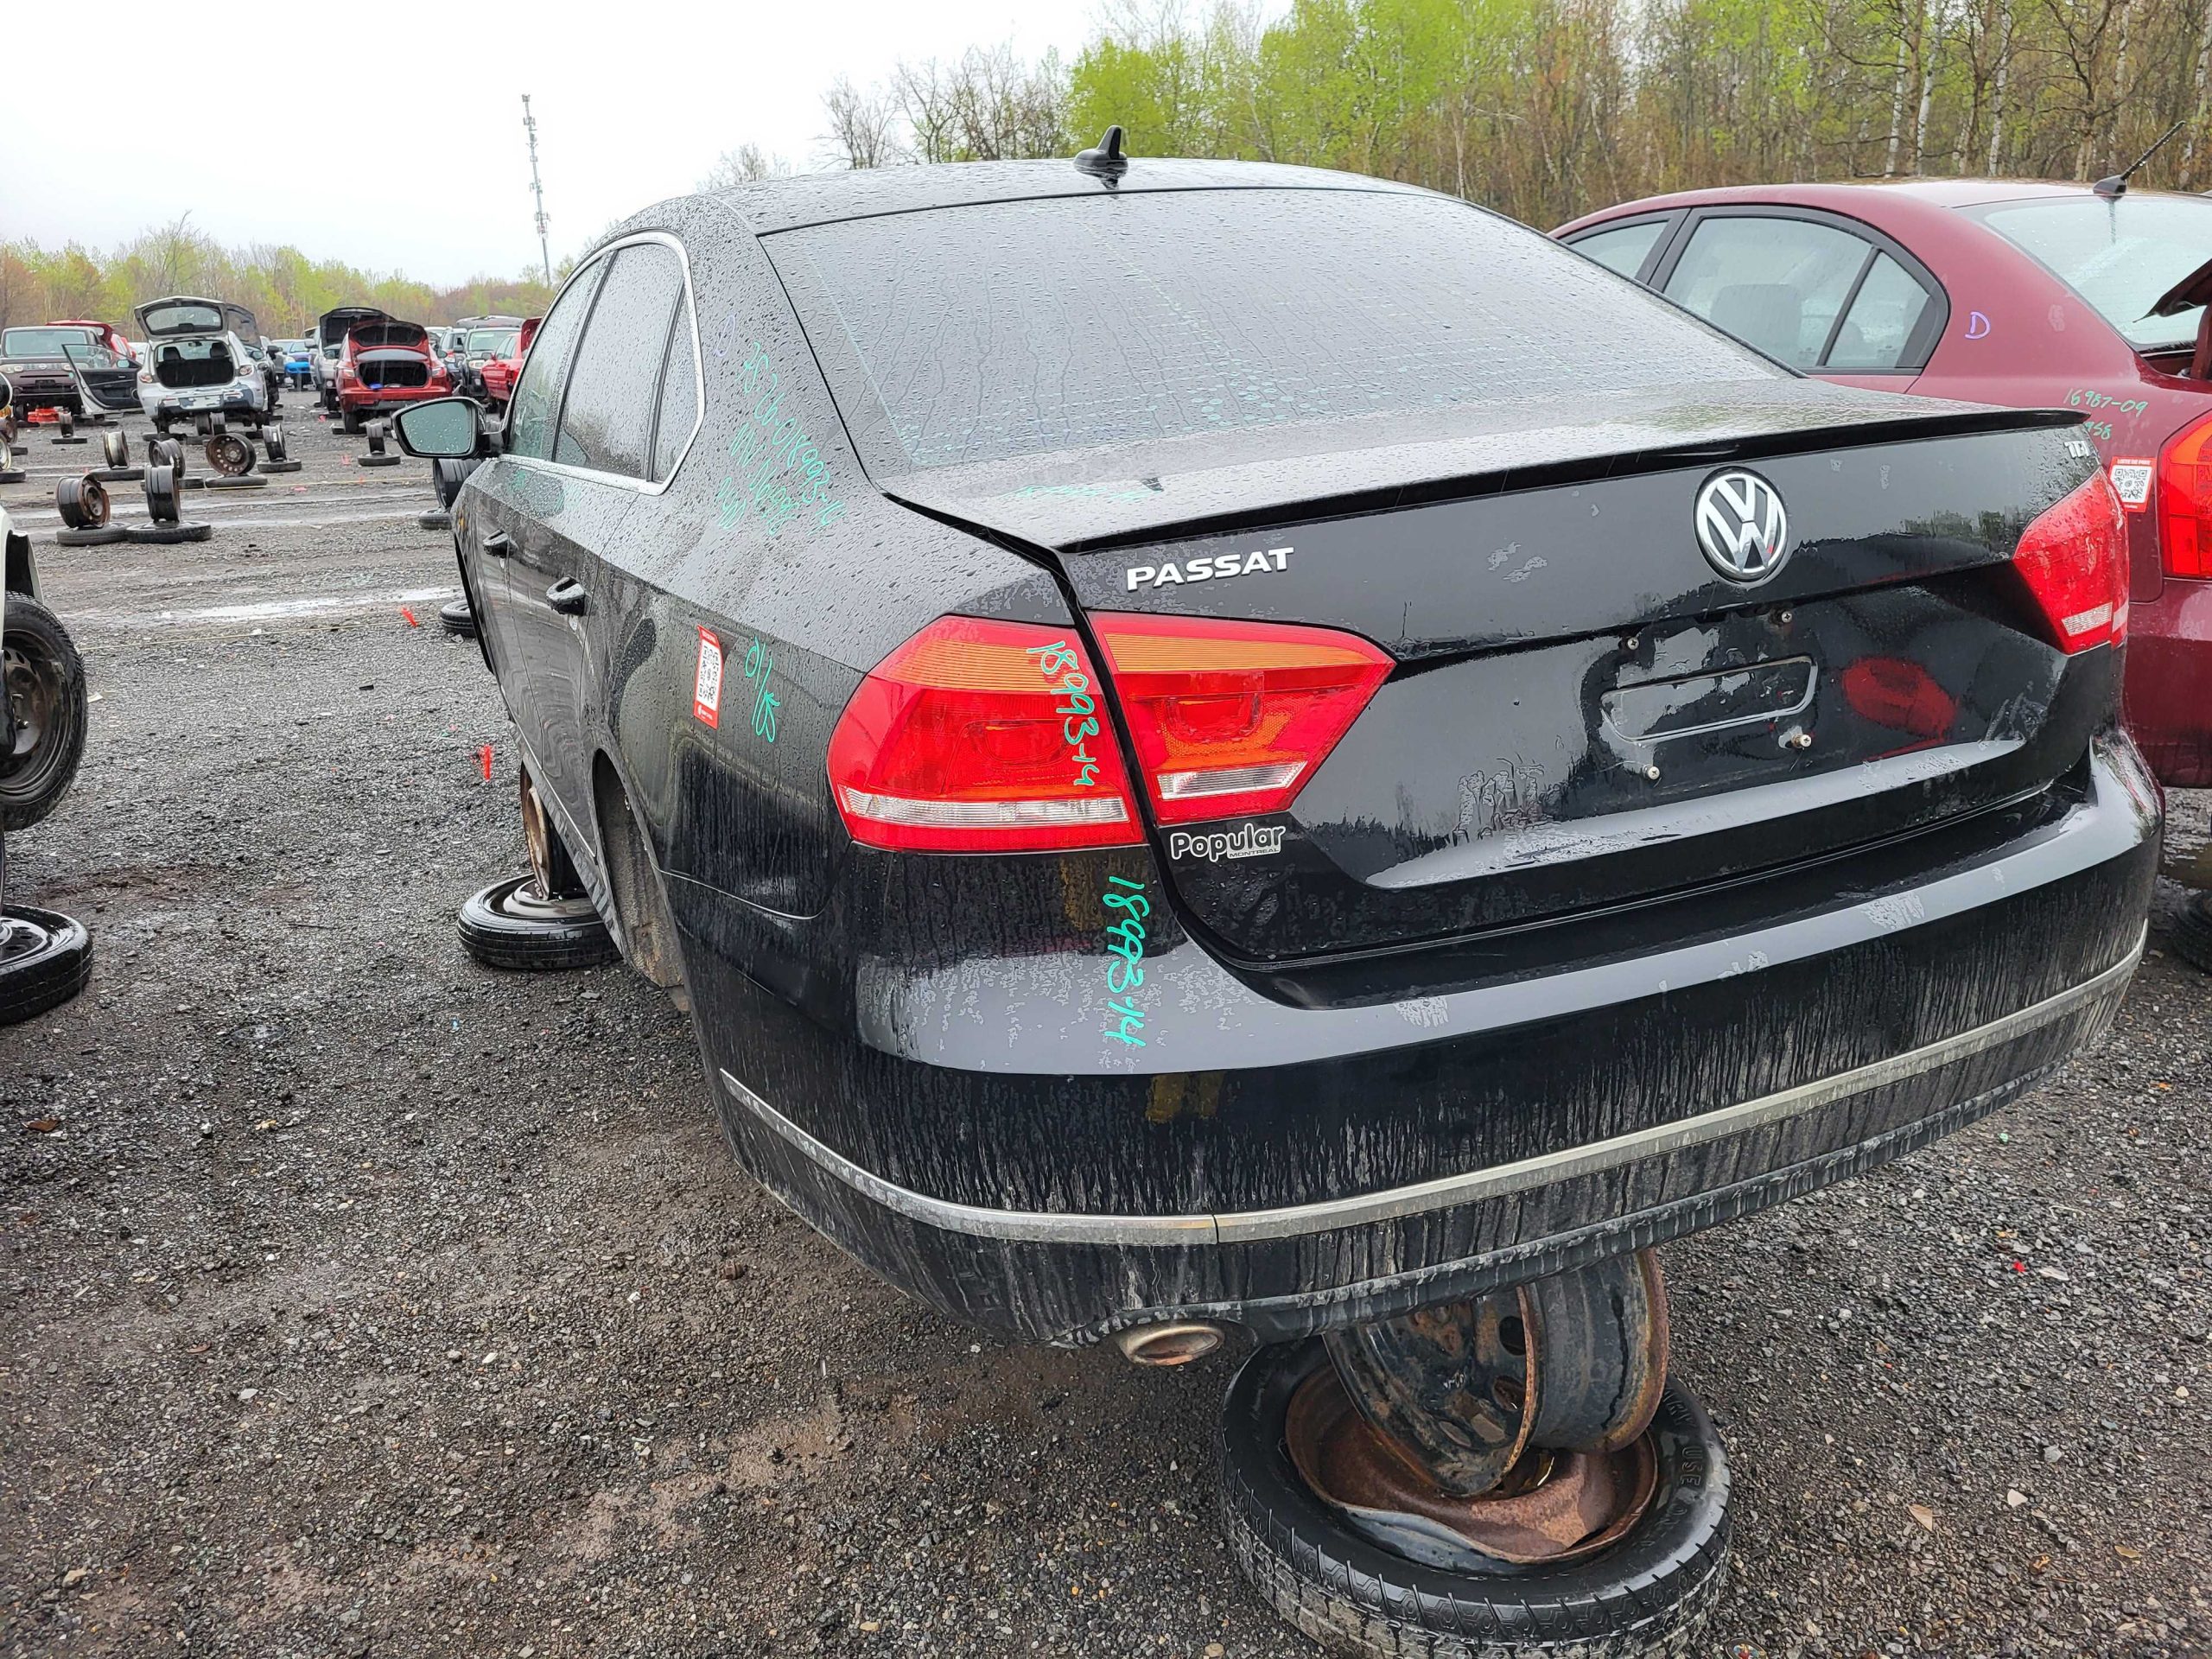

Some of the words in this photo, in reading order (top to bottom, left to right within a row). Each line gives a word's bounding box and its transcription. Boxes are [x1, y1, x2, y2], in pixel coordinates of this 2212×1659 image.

[1965, 311, 1991, 339] D
[2063, 388, 2148, 417] 16987-09
[1697, 473, 1787, 575] VW
[1127, 547, 1294, 591] PASSAT
[1171, 823, 1286, 862] Popular
[1229, 848, 1280, 858] MONTREAL
[1680, 1446, 1704, 1486] USE
